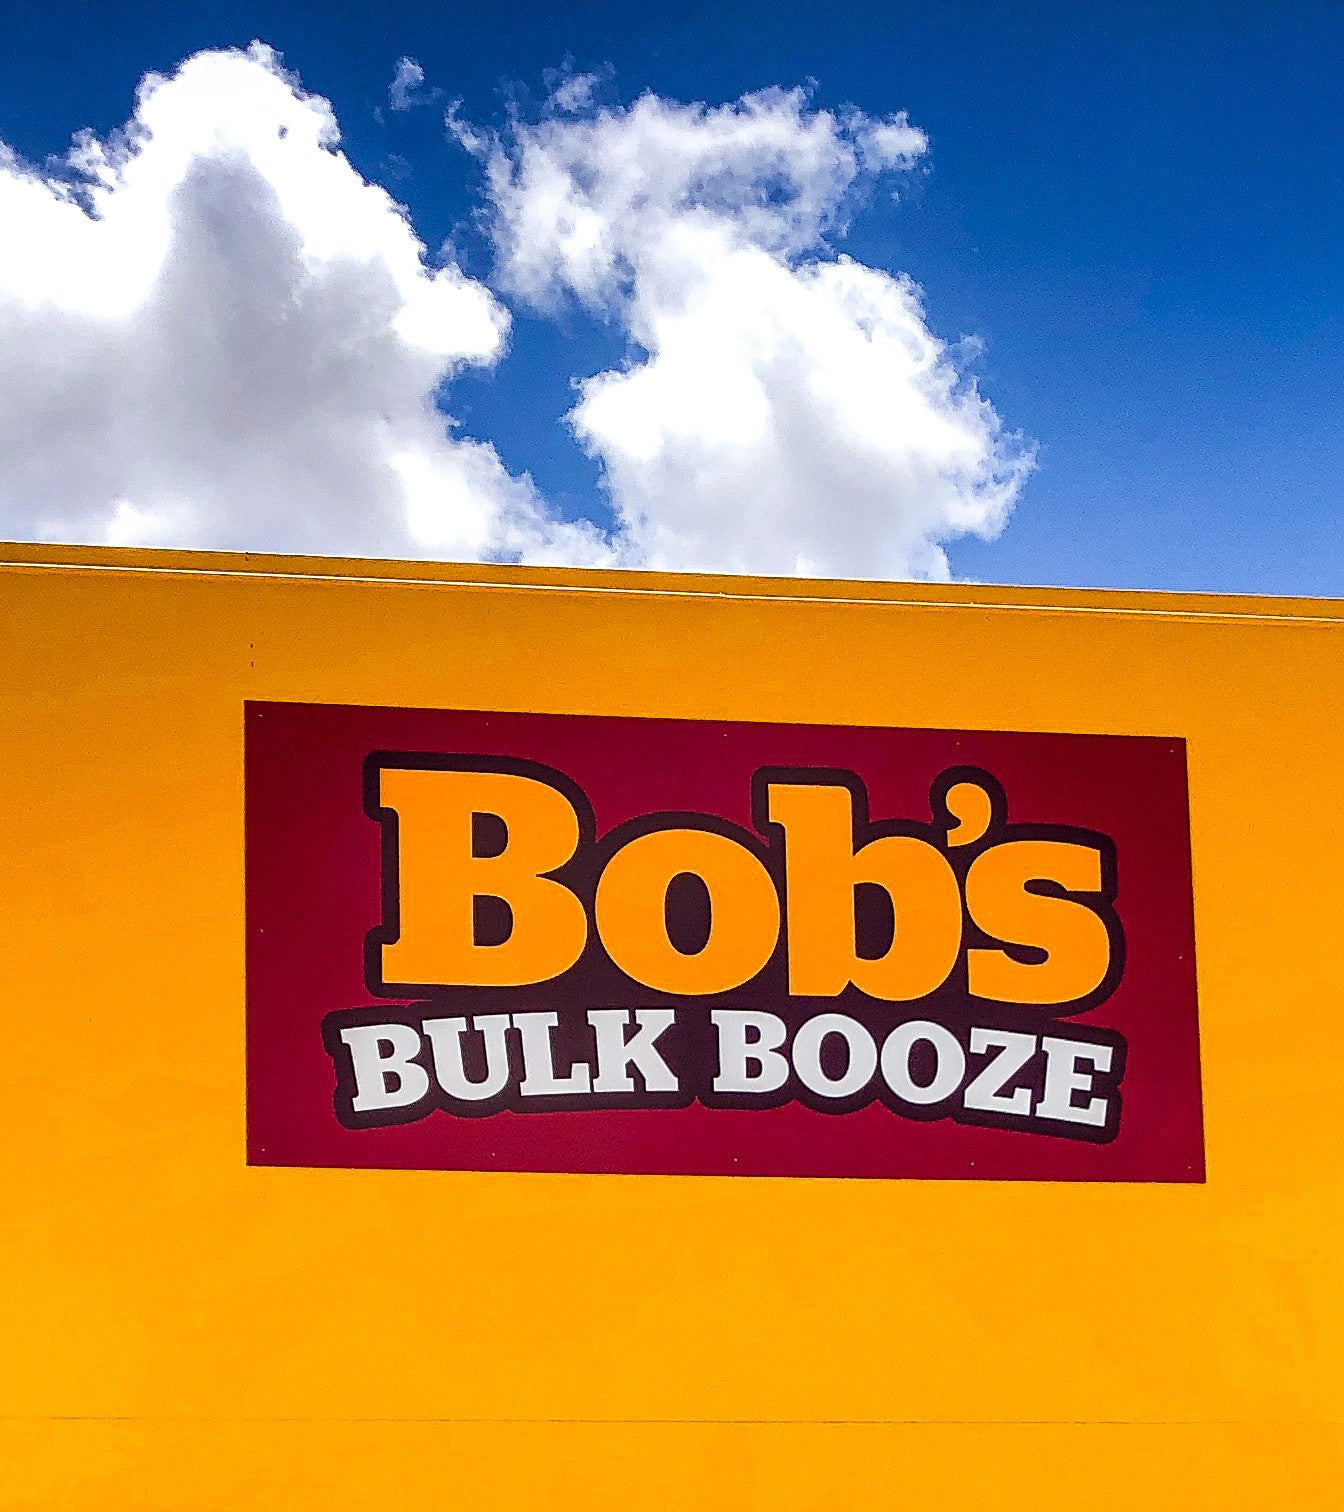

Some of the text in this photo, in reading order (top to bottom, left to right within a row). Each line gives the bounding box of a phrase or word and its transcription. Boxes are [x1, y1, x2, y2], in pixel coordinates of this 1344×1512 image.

[380, 768, 1111, 1005] Bob's
[340, 1010, 1114, 1127] BULK BOOZE
